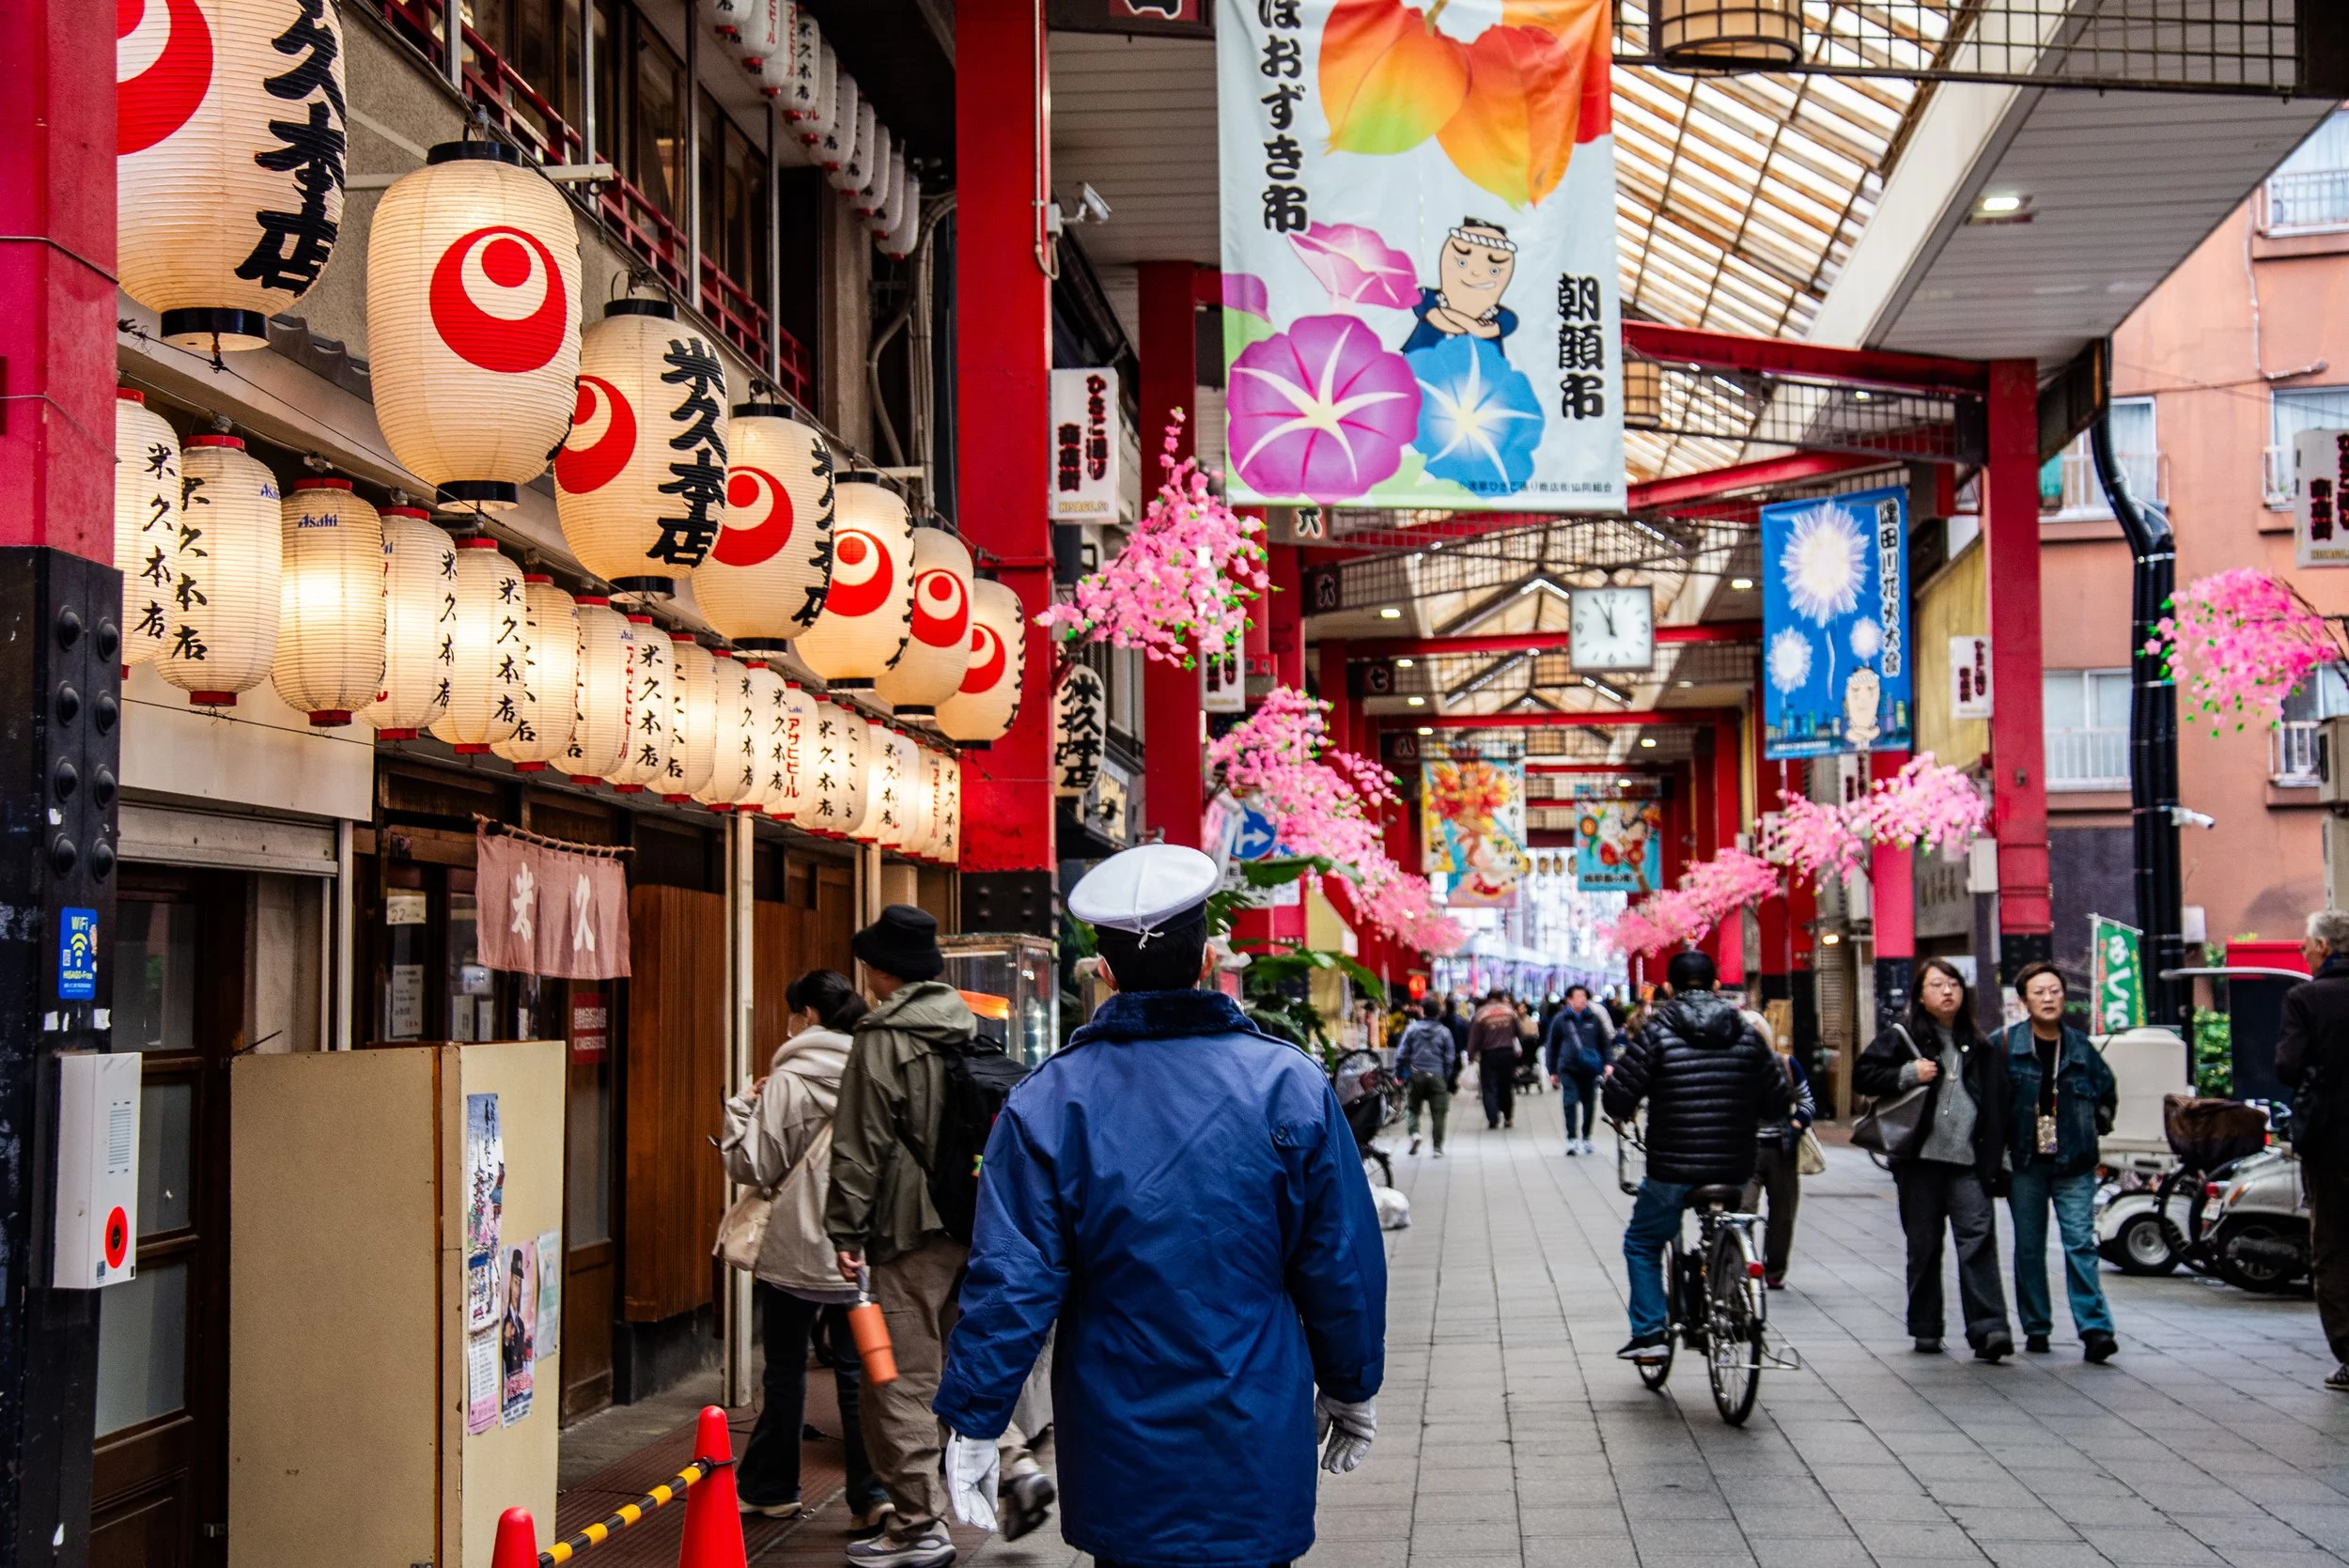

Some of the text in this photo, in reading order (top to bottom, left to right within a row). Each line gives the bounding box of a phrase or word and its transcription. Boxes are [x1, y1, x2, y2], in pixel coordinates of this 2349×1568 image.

[234, 0, 346, 298] 久本店
[1258, 0, 1307, 233] ほおずき市
[1557, 272, 1606, 420] 朝顔市
[646, 337, 728, 568] 米久本店
[133, 442, 176, 640] 米久本店
[298, 513, 338, 528] Asahi
[433, 550, 458, 708] 米久本店
[492, 577, 521, 724] 米久本店
[636, 644, 663, 767] 米久本店
[740, 676, 754, 786] 米久本店
[769, 688, 787, 791] 米久本店
[784, 718, 800, 799] アサヒビール
[816, 720, 836, 817] 米久本店
[880, 742, 896, 825] 米久本店
